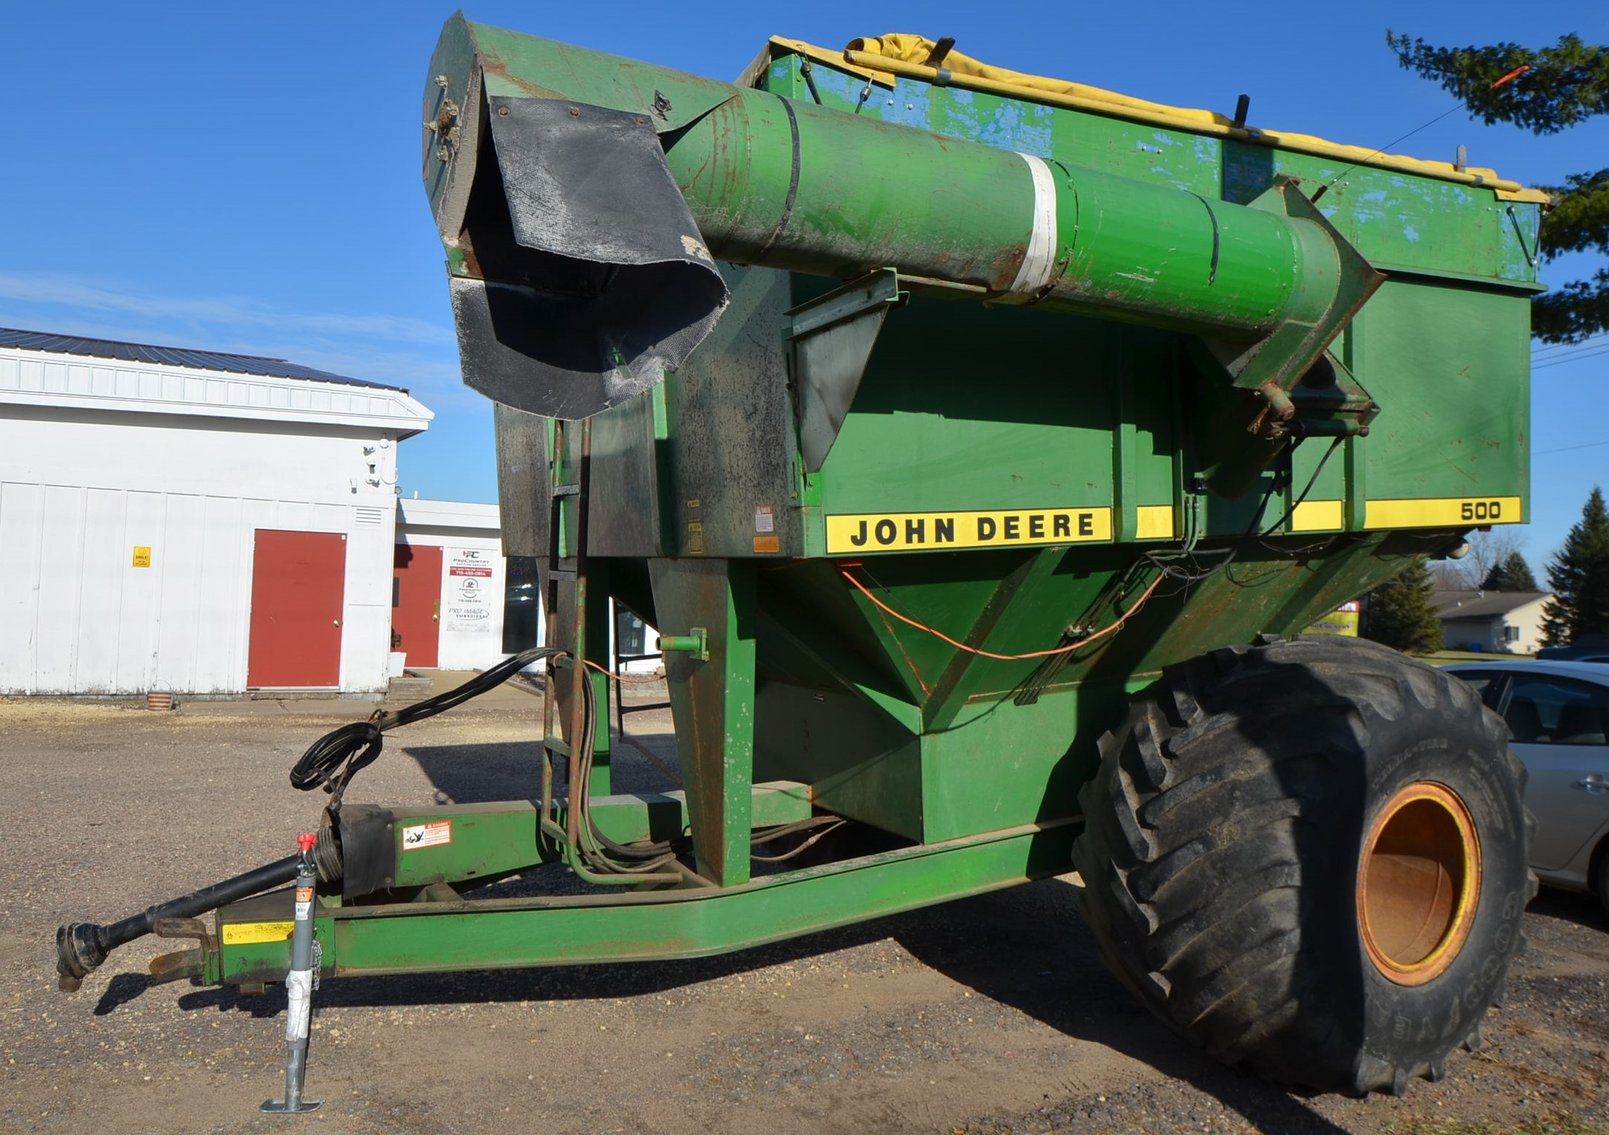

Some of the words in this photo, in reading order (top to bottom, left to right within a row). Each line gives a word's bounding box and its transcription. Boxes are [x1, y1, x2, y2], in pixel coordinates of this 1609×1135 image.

[1461, 502, 1501, 520] 500
[850, 518, 954, 546] JOHN
[977, 513, 1094, 541] DEERE
